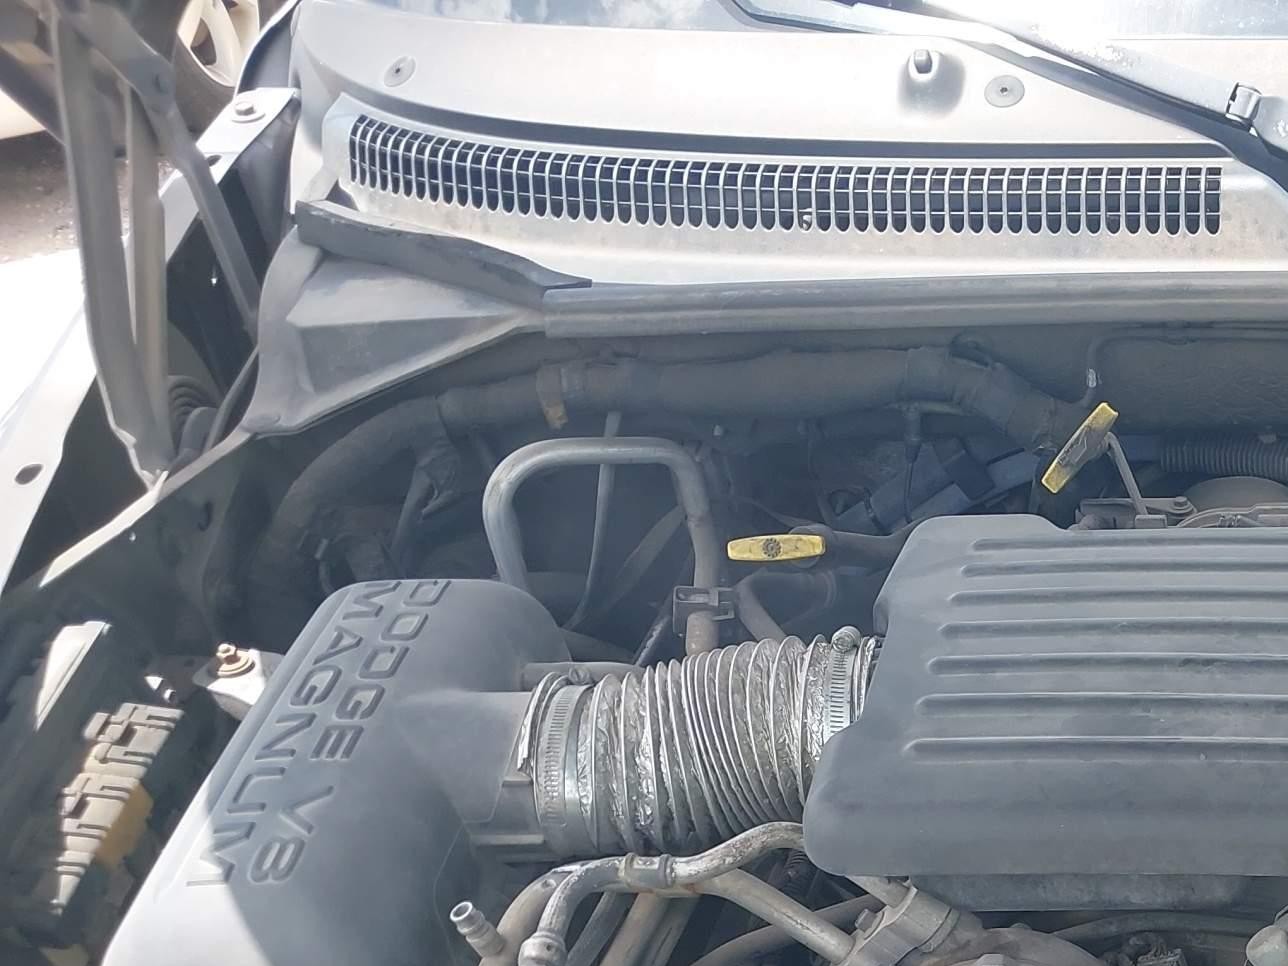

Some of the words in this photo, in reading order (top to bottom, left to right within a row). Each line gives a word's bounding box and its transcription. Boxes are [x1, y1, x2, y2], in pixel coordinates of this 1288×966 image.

[186, 580, 402, 888] MAGNUM
[309, 579, 451, 761] DODGE
[248, 785, 334, 884] V8
